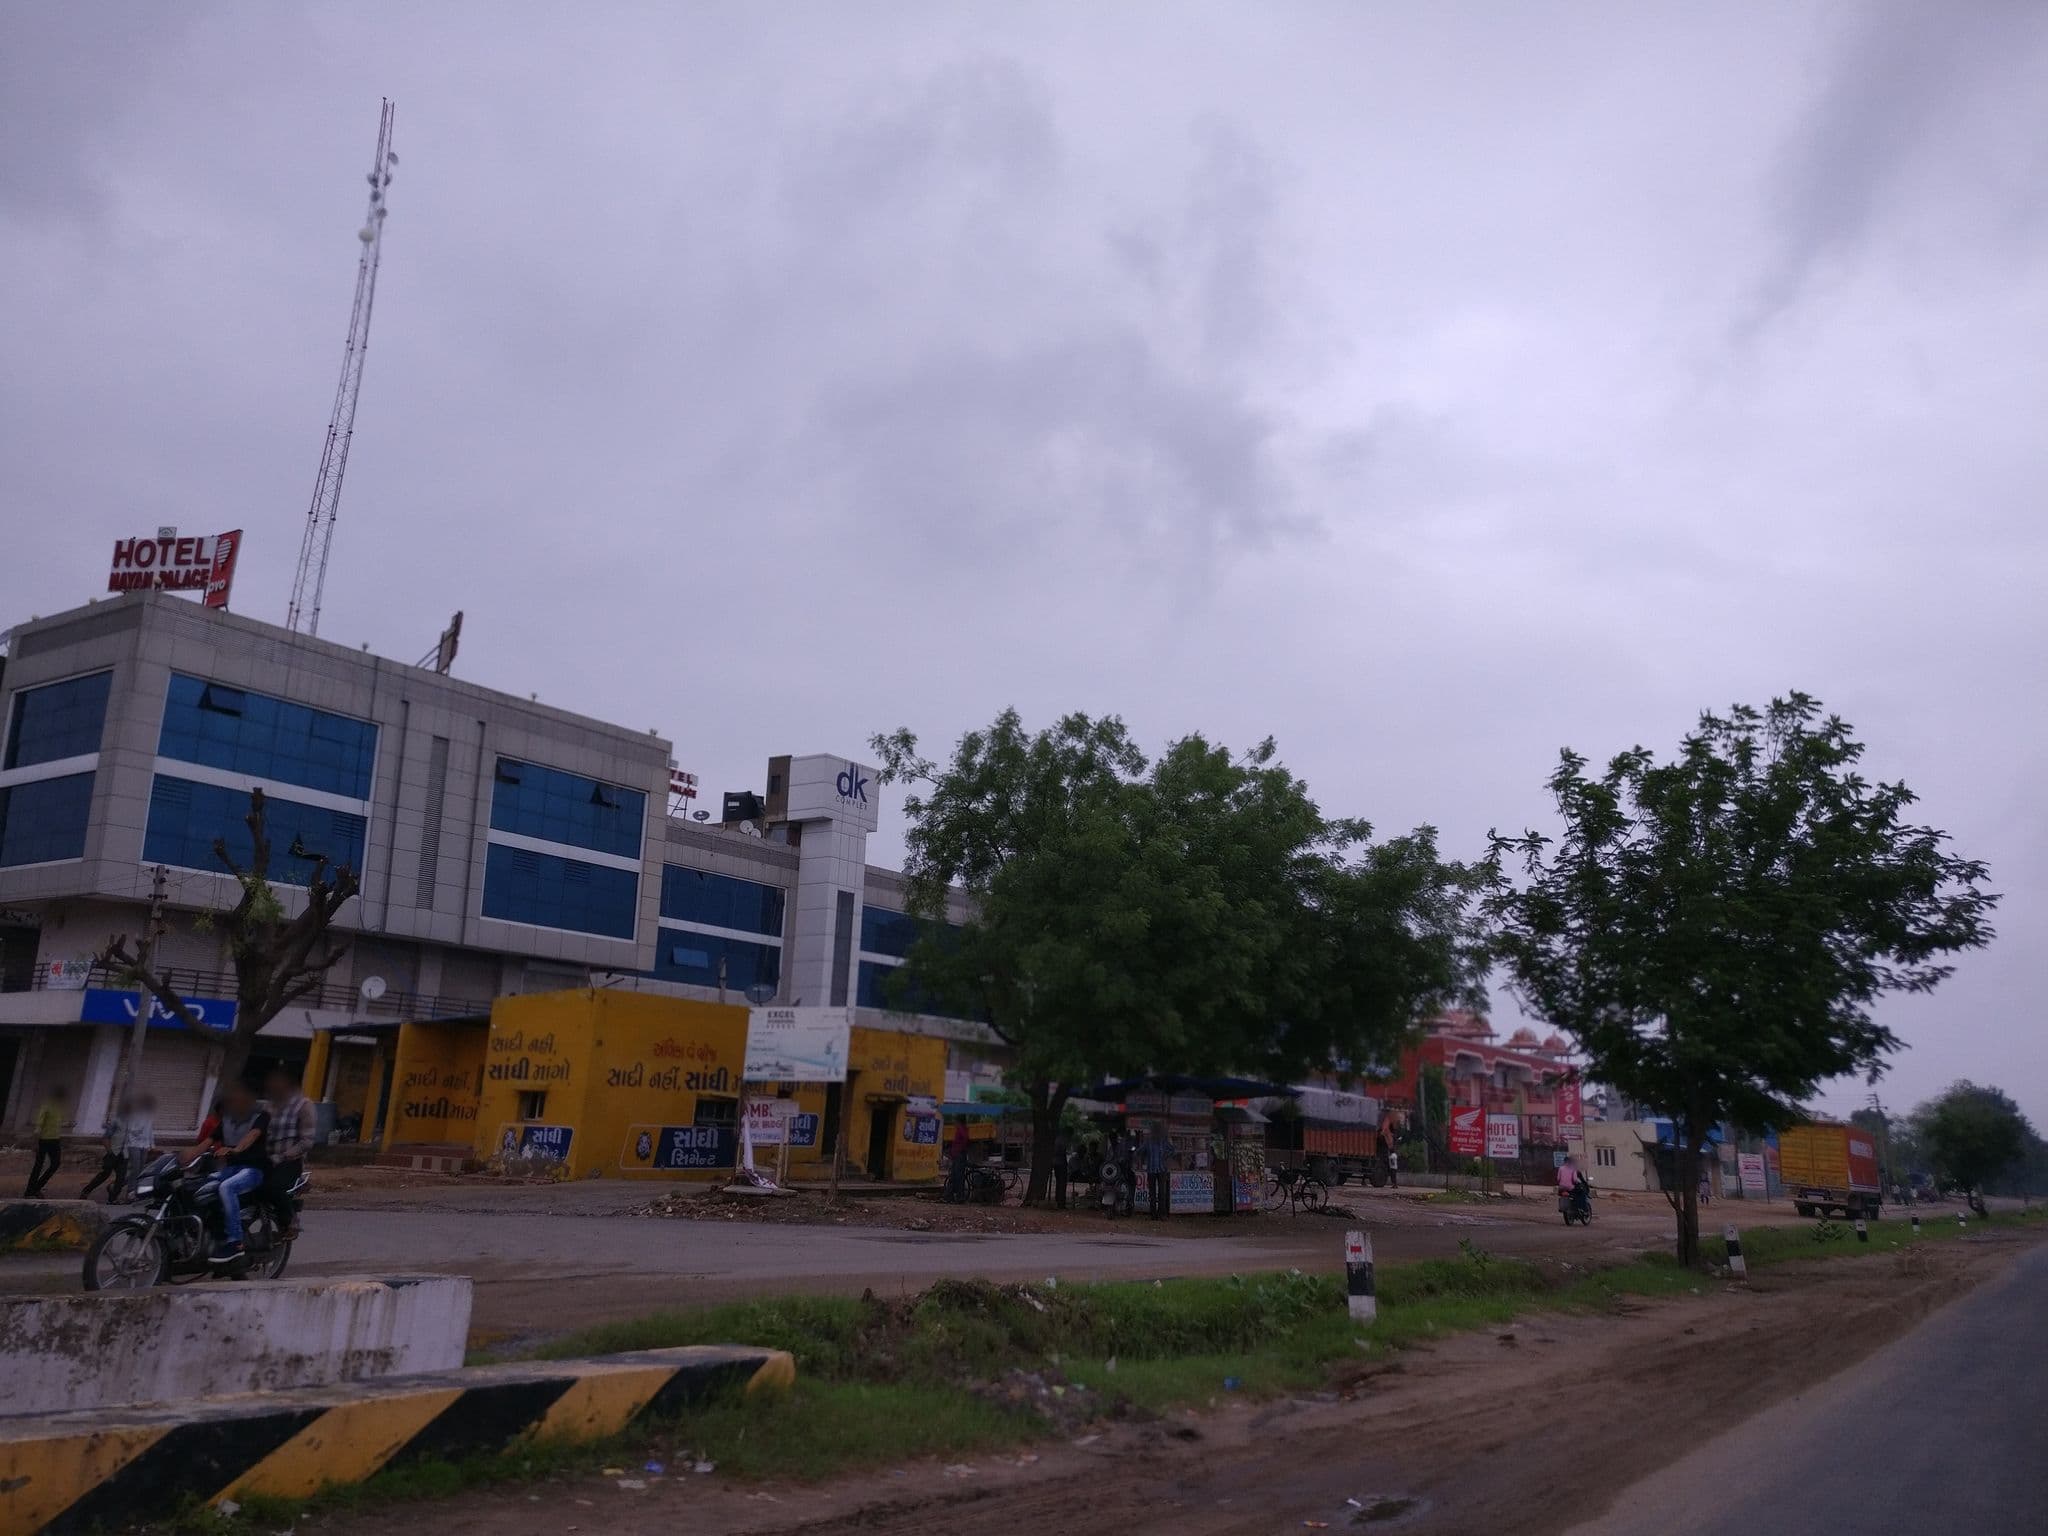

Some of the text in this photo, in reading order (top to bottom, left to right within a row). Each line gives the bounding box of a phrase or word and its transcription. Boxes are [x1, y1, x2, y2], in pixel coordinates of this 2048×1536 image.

[113, 537, 211, 568] HOTEL
[208, 579, 226, 592] OYO
[836, 763, 869, 803] dk
[1487, 1122, 1517, 1137] HOTEL
